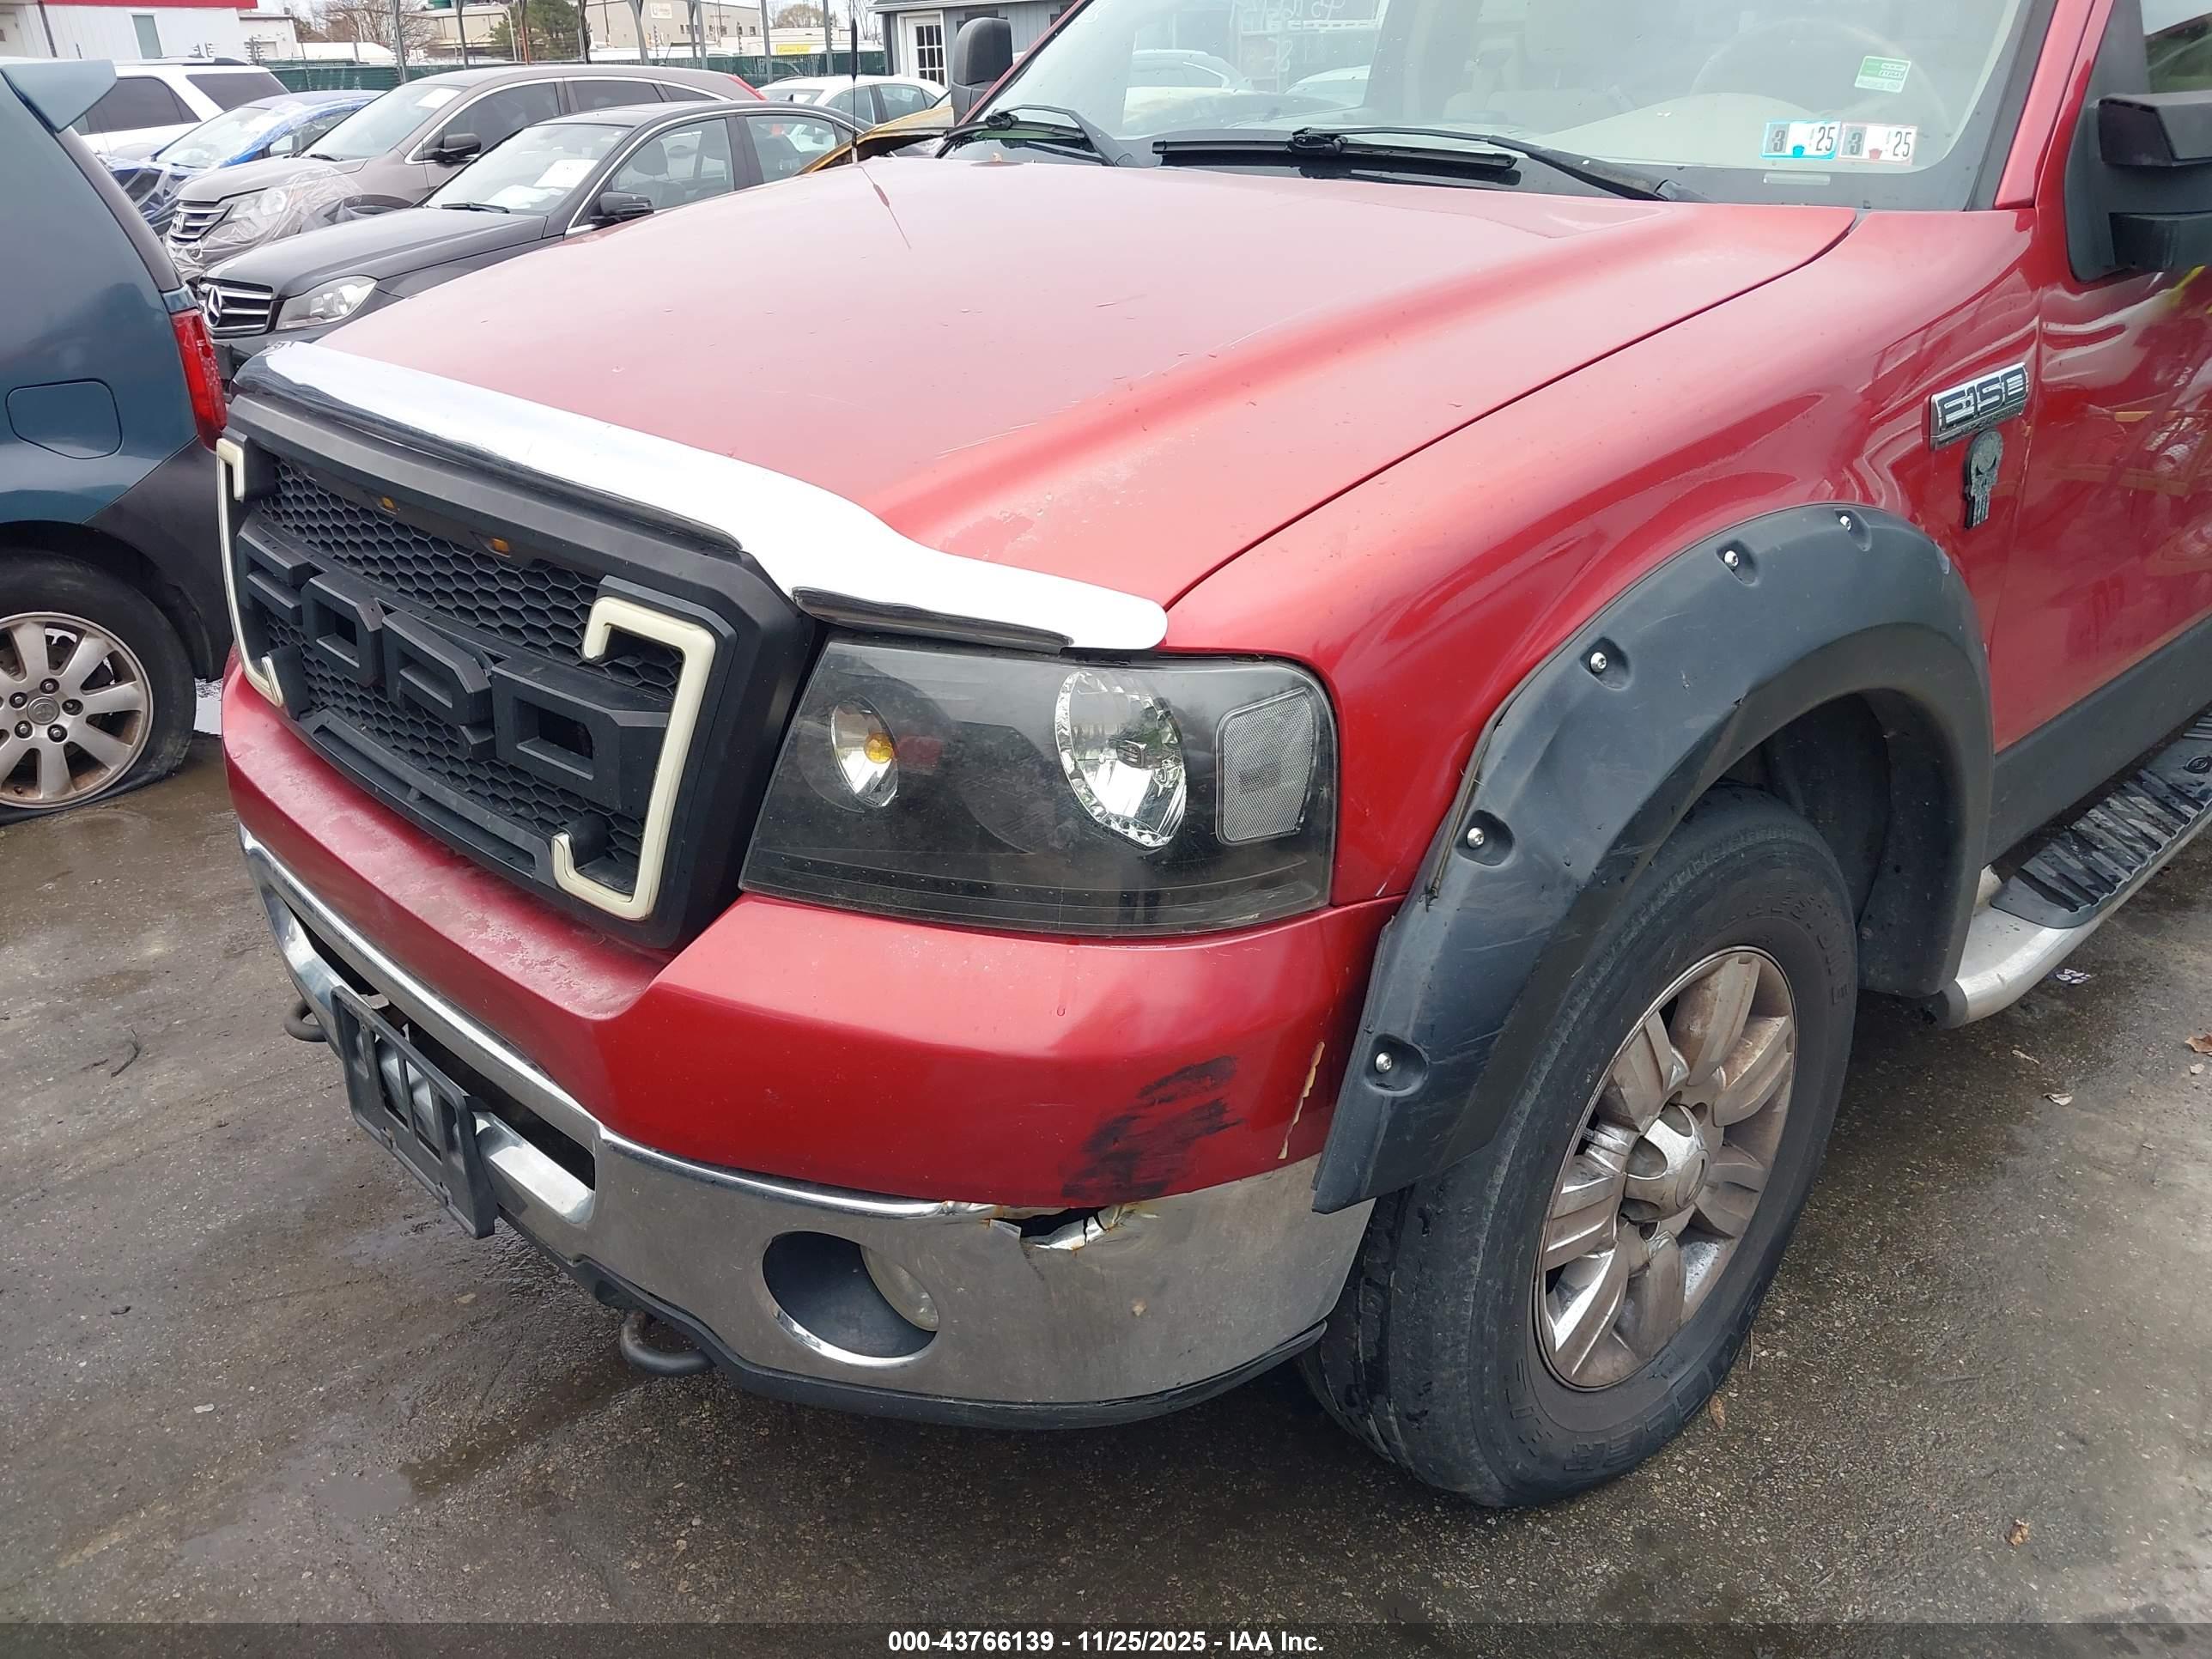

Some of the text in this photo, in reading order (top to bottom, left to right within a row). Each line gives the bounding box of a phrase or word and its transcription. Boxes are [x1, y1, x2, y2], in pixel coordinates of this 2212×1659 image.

[1771, 130, 1786, 152] 3
[1814, 126, 1836, 152] 25
[1849, 131, 1863, 155] 3
[1893, 131, 1912, 157] 25
[236, 517, 671, 812] FORD
